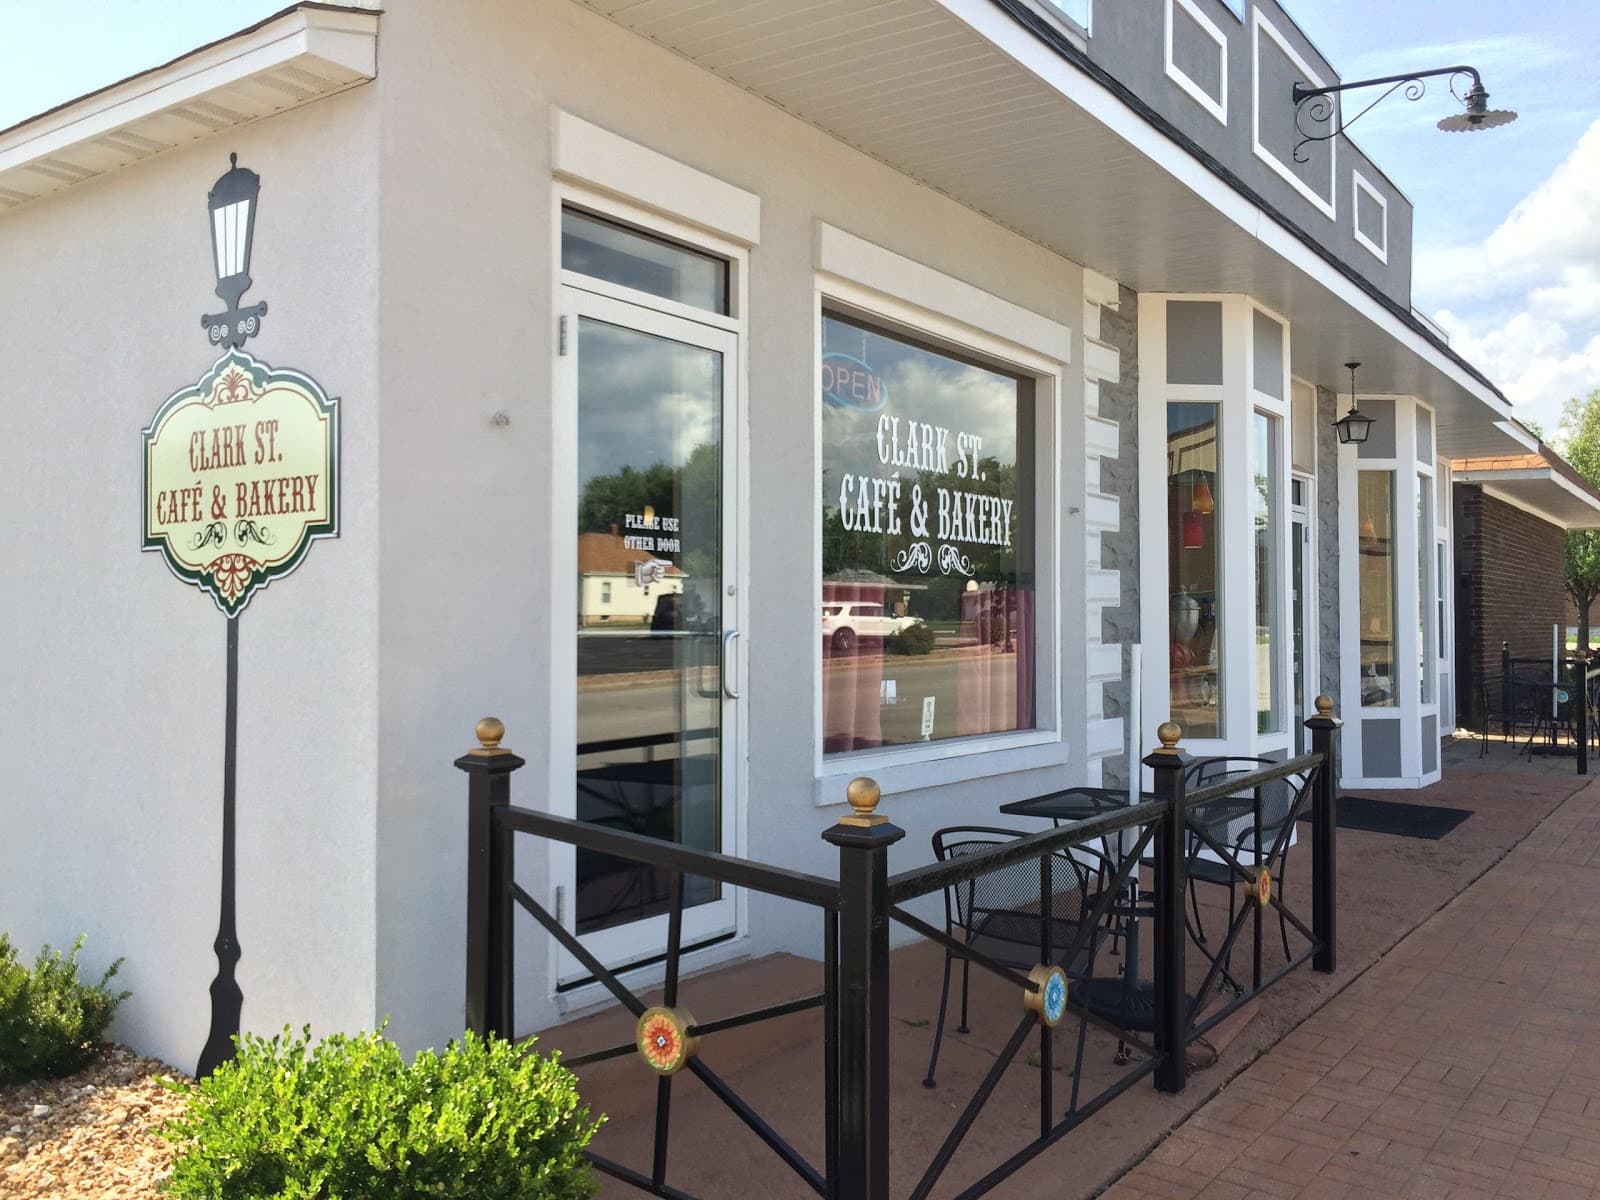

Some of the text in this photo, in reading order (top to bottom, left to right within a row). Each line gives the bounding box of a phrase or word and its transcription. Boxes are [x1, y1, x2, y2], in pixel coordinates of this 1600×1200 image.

[822, 364, 880, 403] OPEN
[189, 419, 283, 472] CLARK ST.
[876, 414, 986, 482] CLARK ST.
[156, 474, 319, 526] CAFÉ & BAKERY
[625, 514, 679, 531] PLEE USE
[839, 471, 1013, 546] CAFÉ & BAKERY
[624, 536, 680, 552] OTHER DOOR
